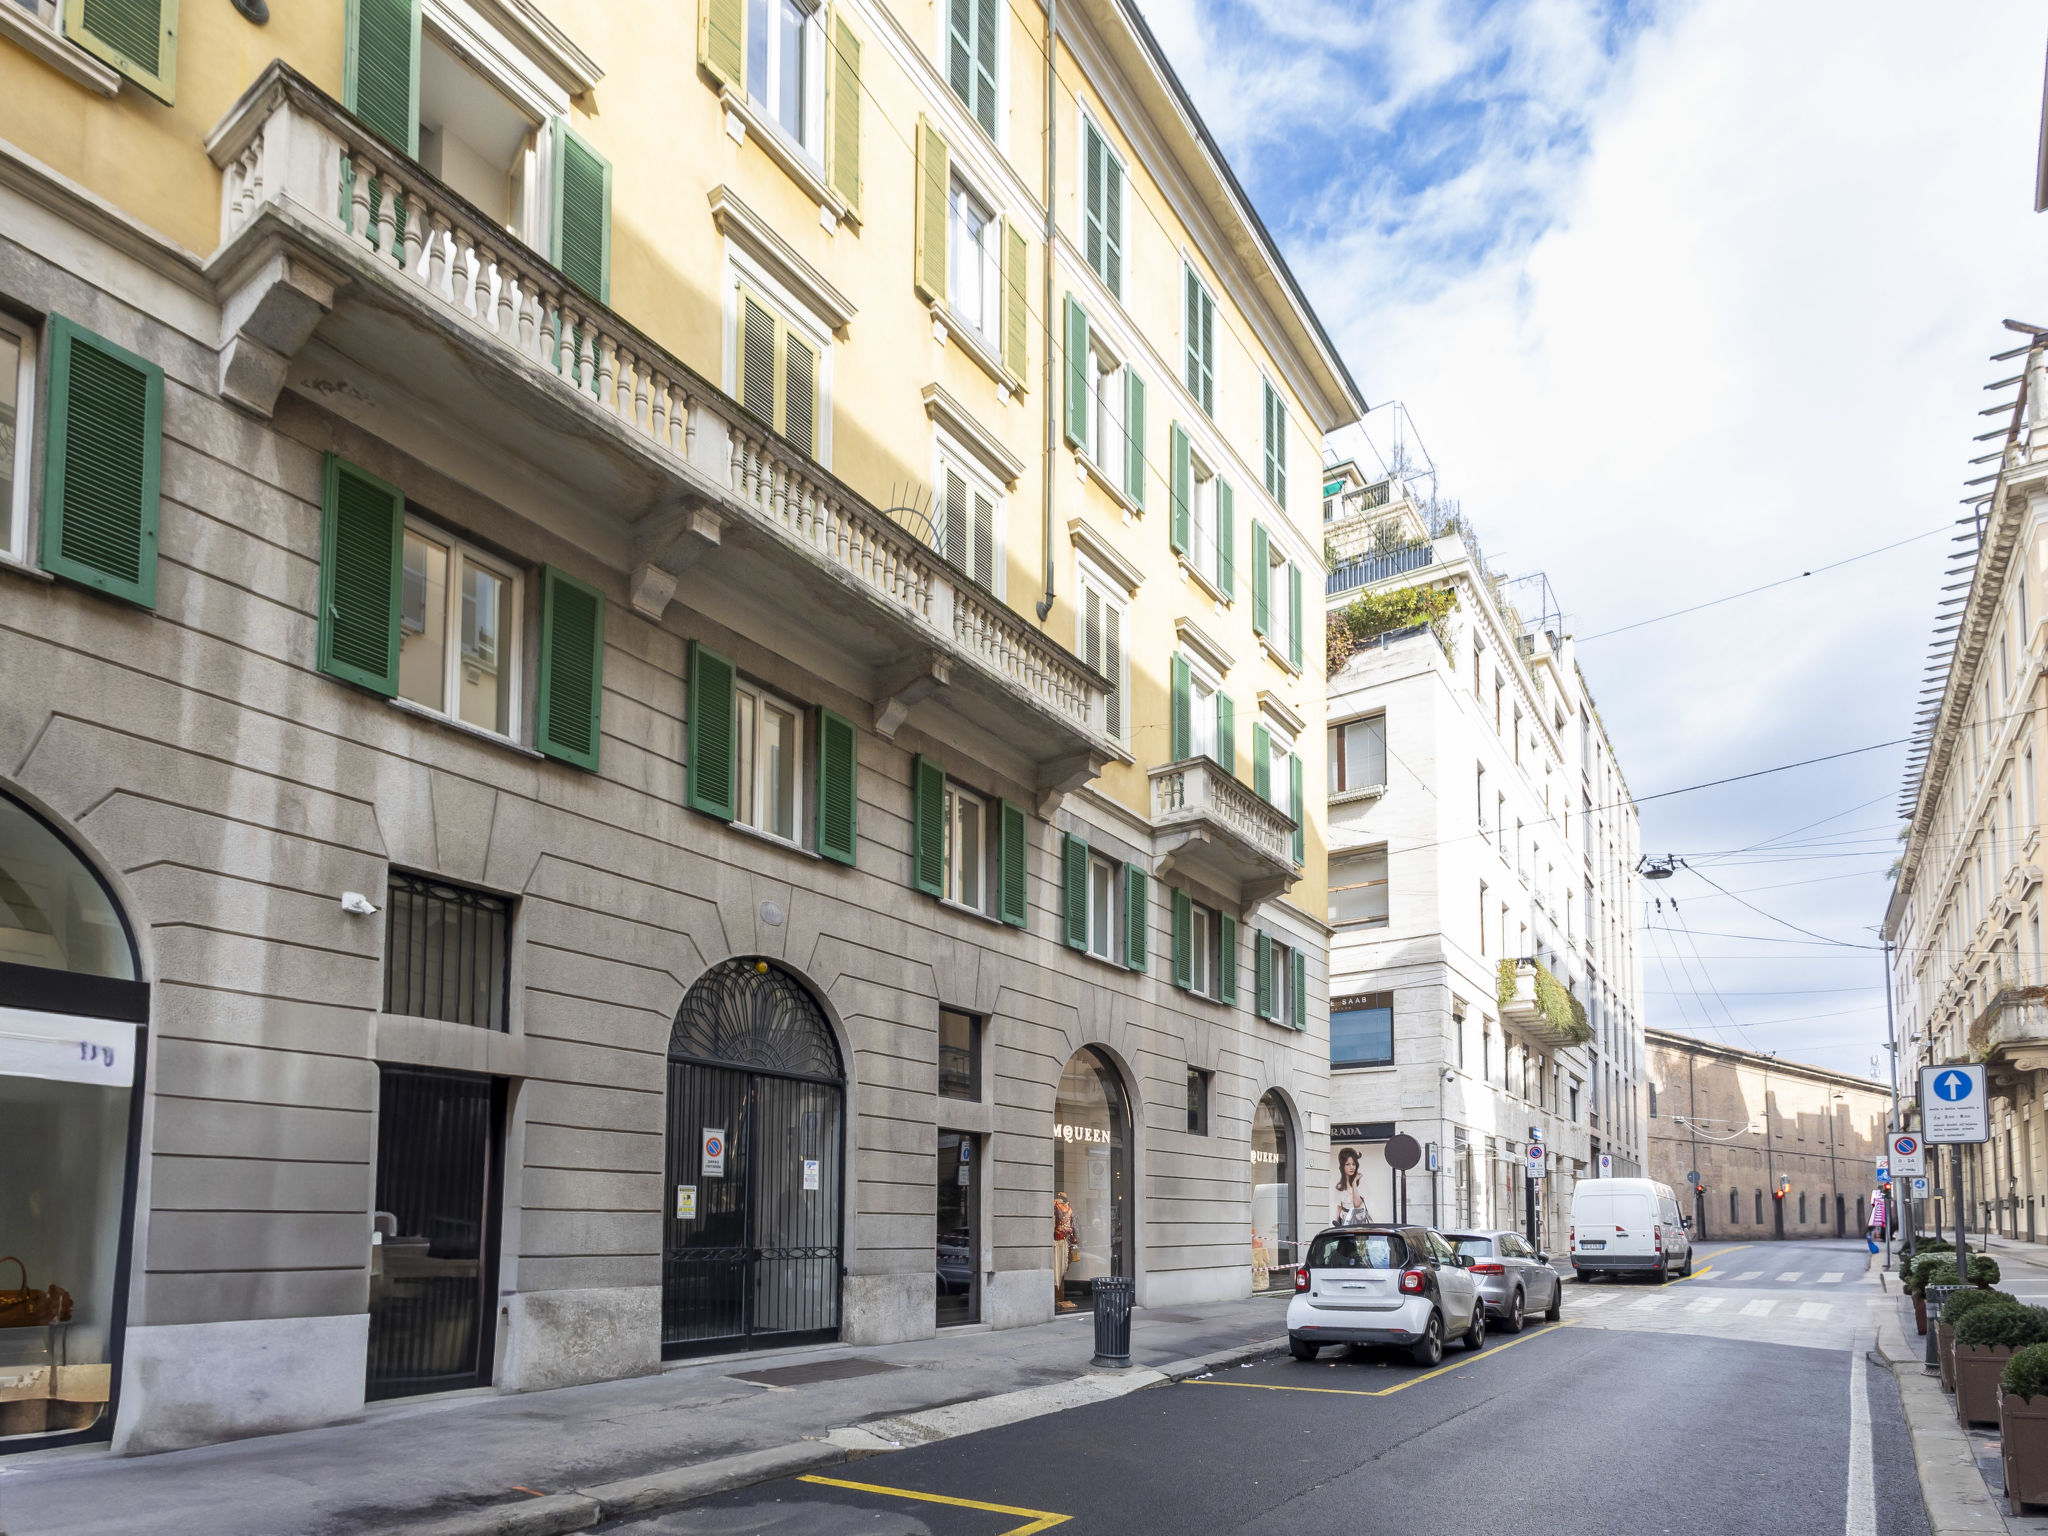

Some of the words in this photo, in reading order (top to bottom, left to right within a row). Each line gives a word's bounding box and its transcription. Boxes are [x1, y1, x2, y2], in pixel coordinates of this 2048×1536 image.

[1341, 996, 1367, 1006] SAAB
[1330, 1127, 1362, 1136] RADA
[1250, 1149, 1280, 1164] QUEEN
